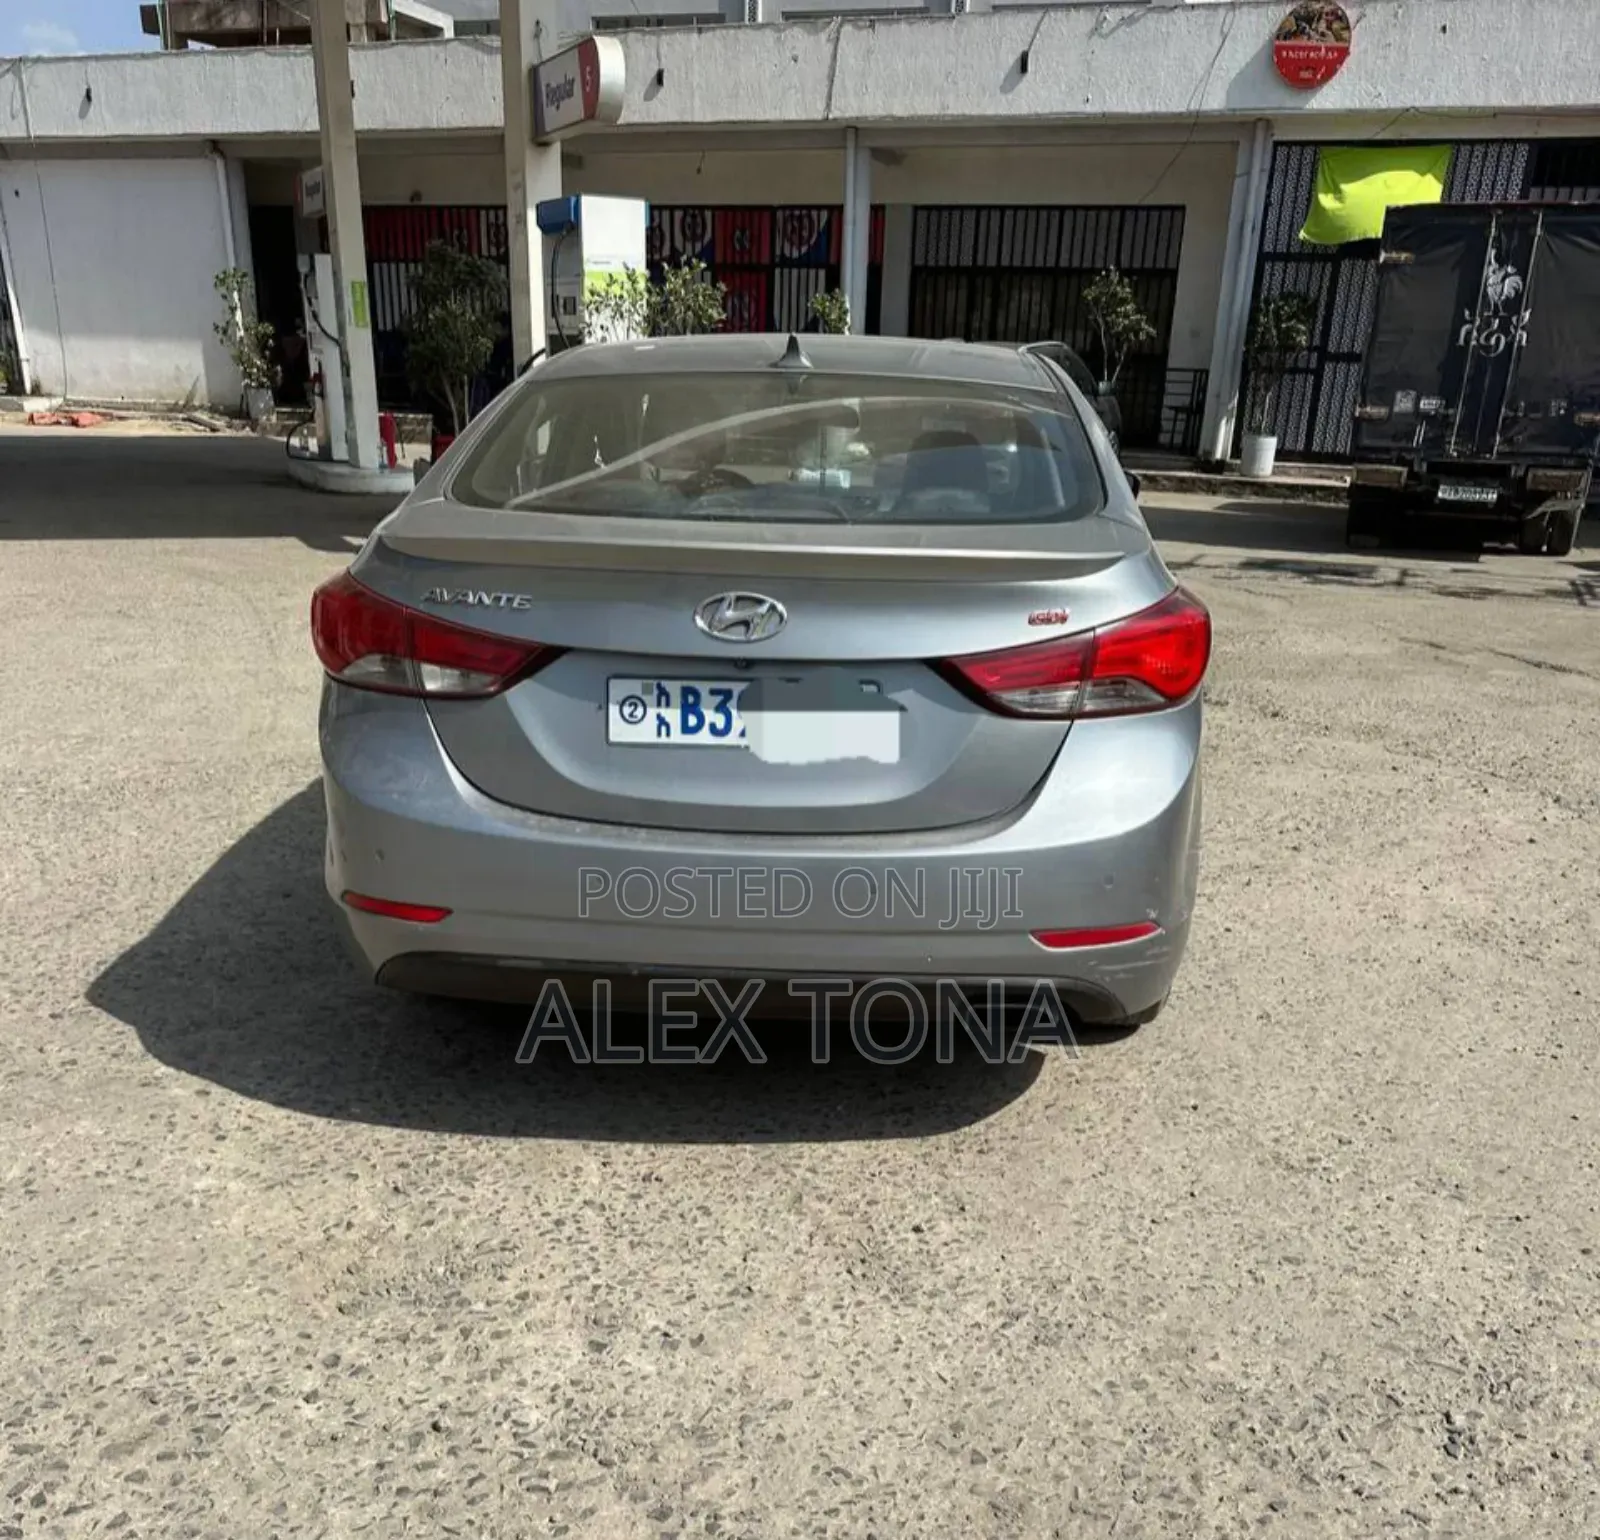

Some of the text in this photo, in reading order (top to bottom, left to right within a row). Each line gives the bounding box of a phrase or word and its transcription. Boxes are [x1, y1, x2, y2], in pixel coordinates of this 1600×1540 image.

[545, 72, 576, 112] Regular
[421, 587, 532, 609] AVANTE
[680, 686, 747, 738] B3
